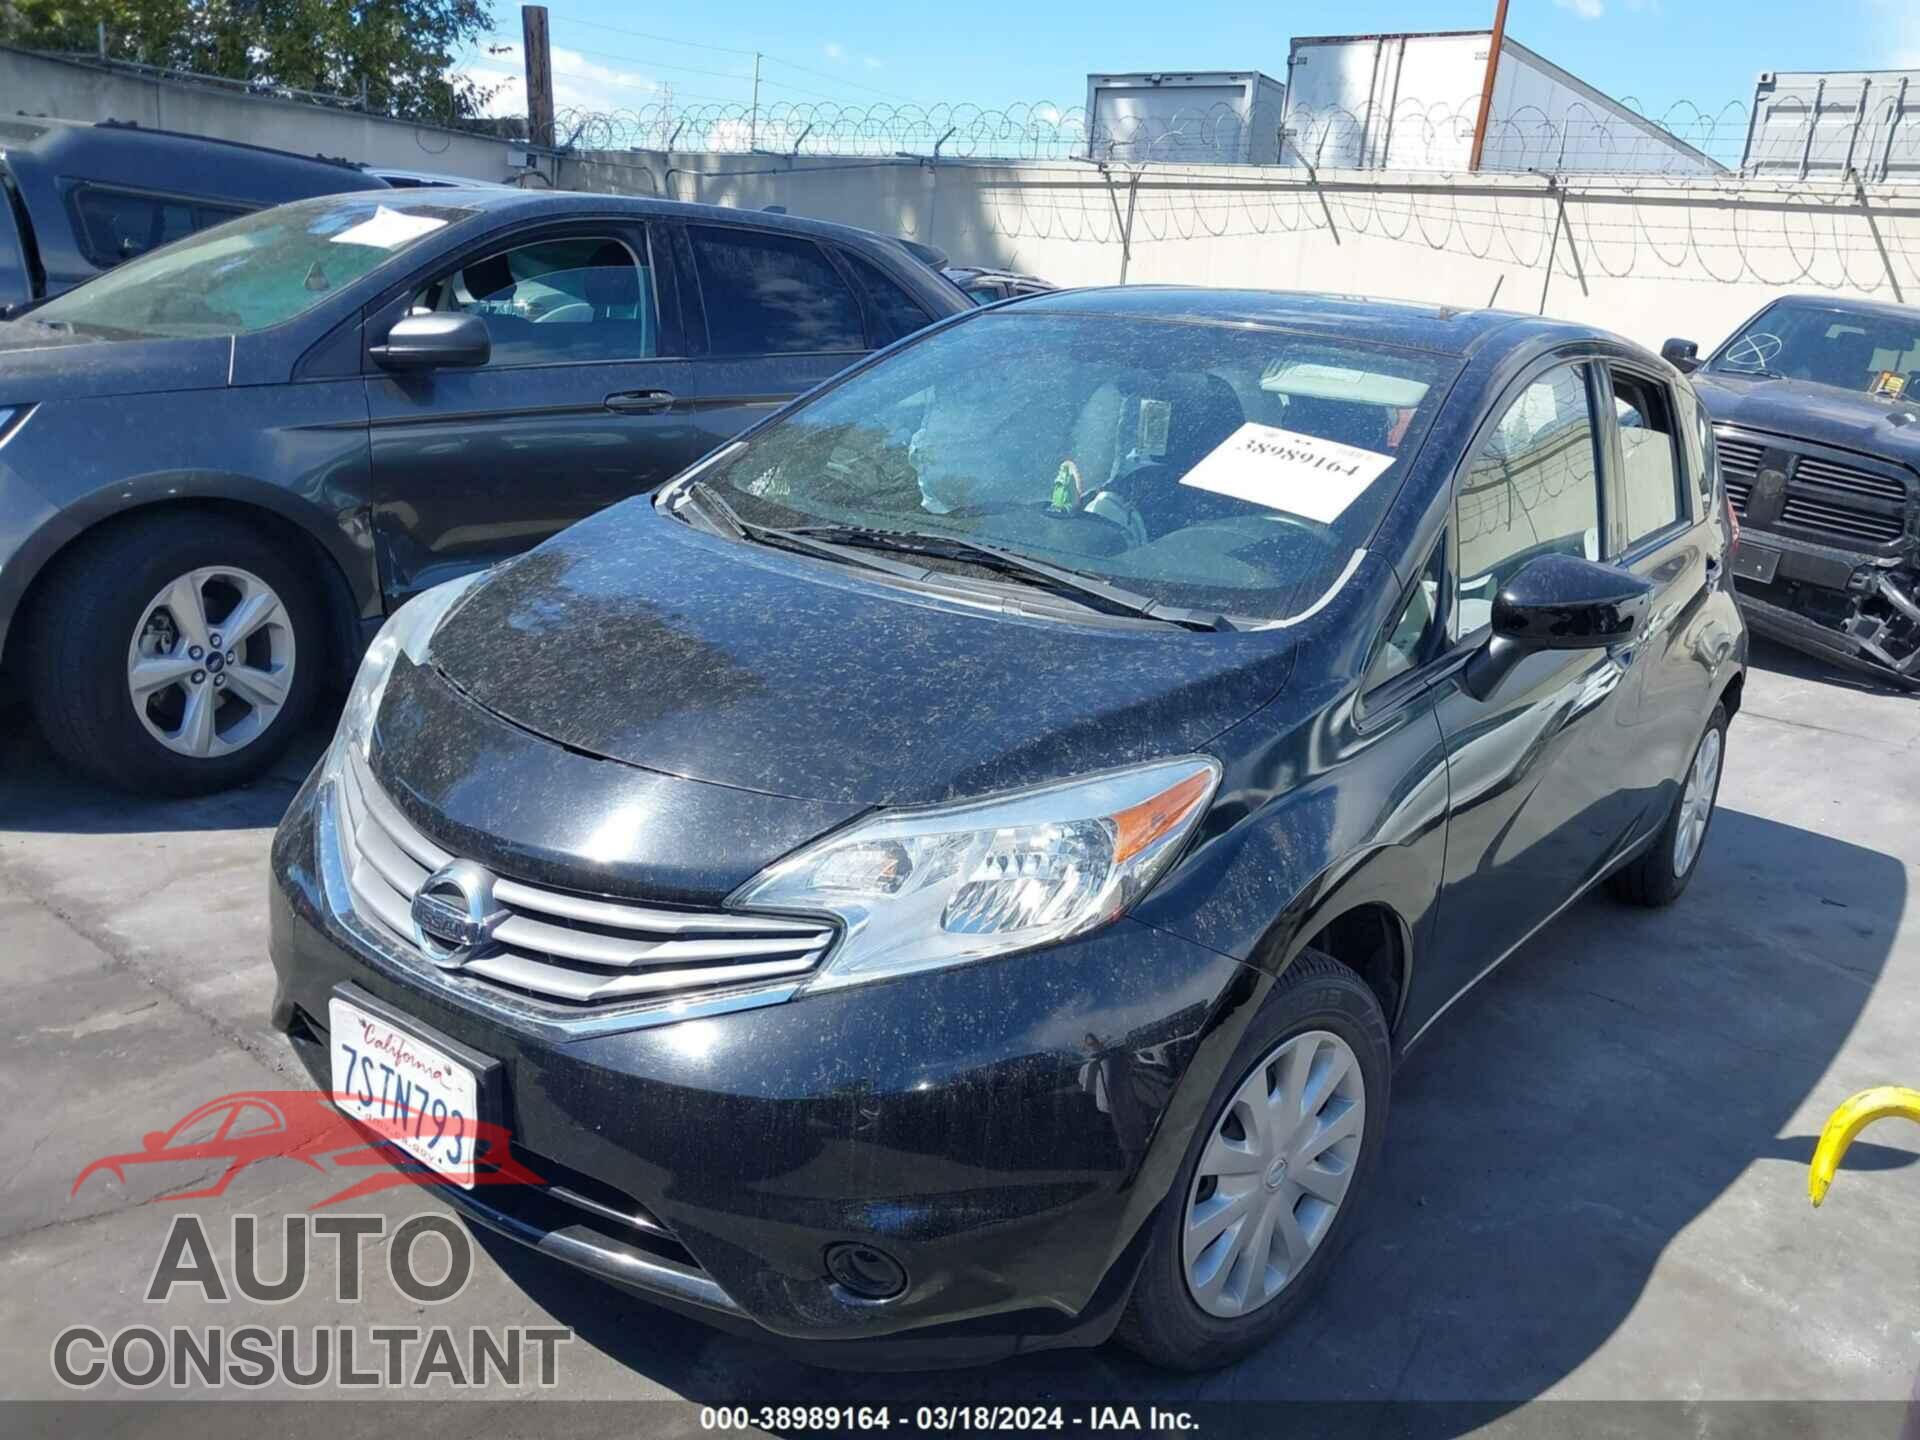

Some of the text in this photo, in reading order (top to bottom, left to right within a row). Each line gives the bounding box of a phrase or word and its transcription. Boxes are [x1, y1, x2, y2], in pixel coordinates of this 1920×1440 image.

[1237, 438, 1360, 476] 38989164
[362, 1021, 450, 1089] California
[341, 1043, 465, 1165] 7STN793
